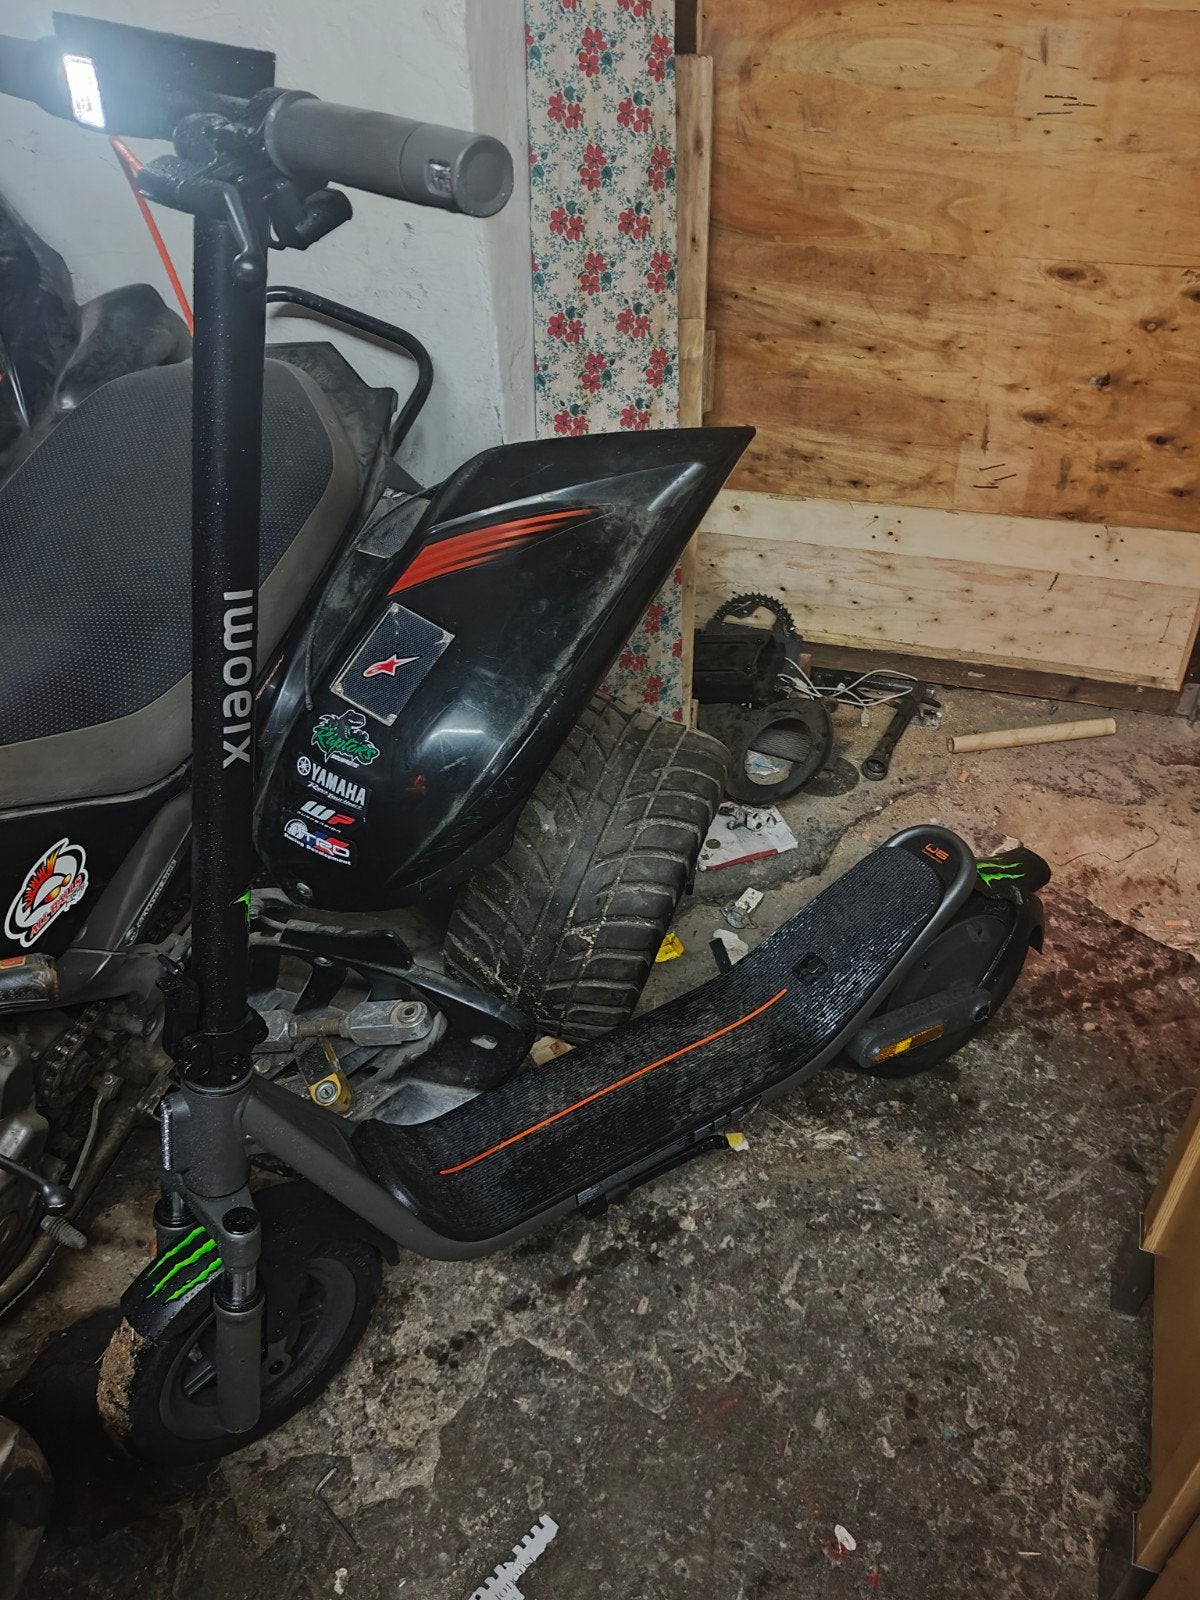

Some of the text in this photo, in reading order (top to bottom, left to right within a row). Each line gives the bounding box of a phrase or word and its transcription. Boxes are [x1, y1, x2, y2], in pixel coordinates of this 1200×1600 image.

[223, 589, 253, 769] xiaomi
[311, 763, 366, 806] YAMAHA
[300, 800, 356, 825] WP
[302, 830, 350, 858] TRD
